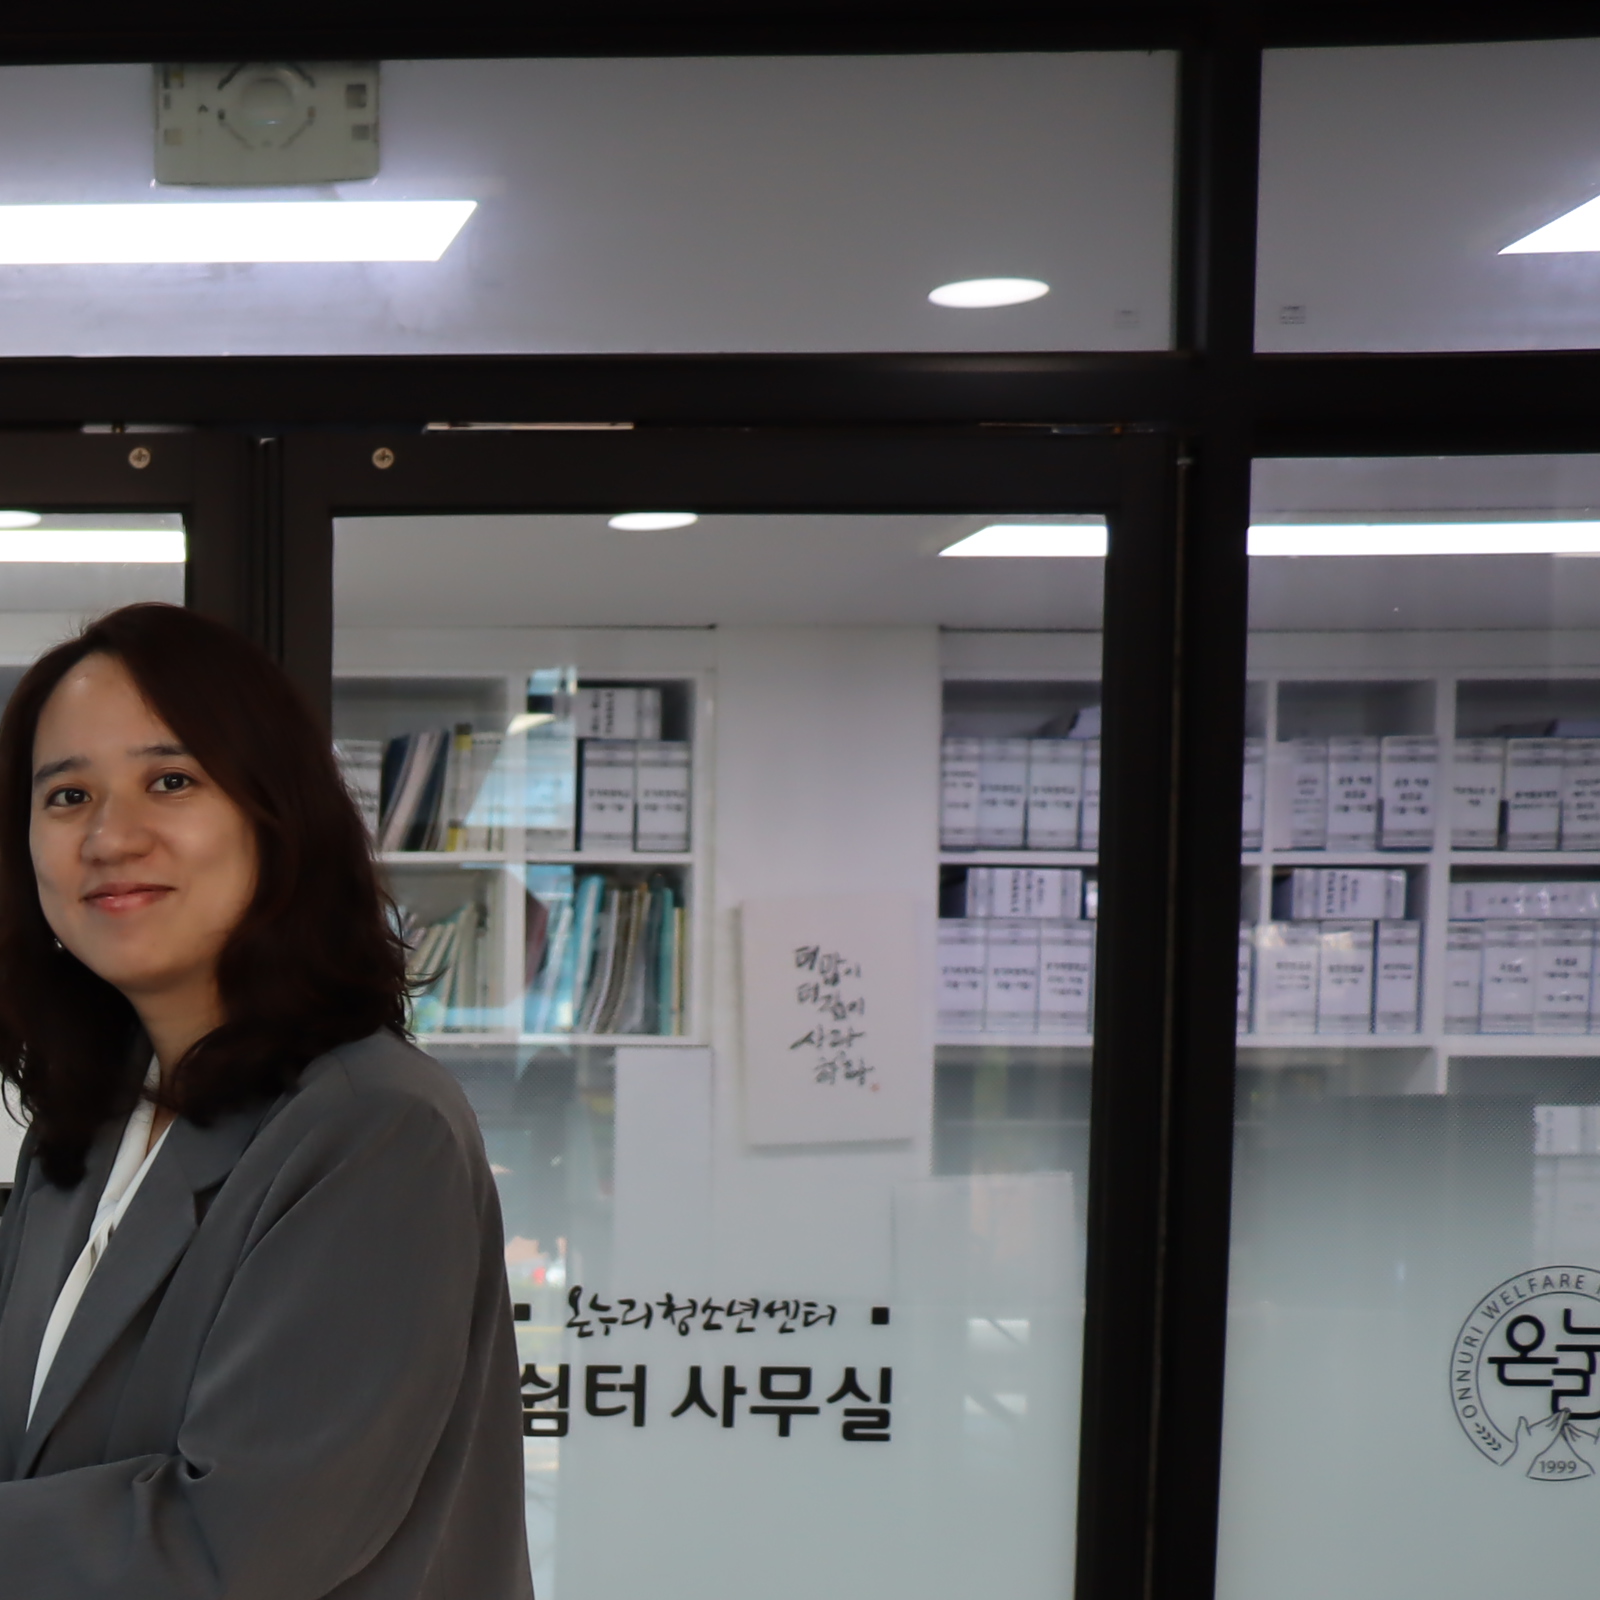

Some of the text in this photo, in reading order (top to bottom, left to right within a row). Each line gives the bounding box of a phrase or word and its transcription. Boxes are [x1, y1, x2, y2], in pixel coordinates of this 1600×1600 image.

[566, 1285, 837, 1338] 온누리청소년센터
[1455, 1273, 1586, 1419] ONNURI WELFARE
[520, 1363, 893, 1442] 쉼터 사무실
[1539, 1460, 1577, 1474] 1999
